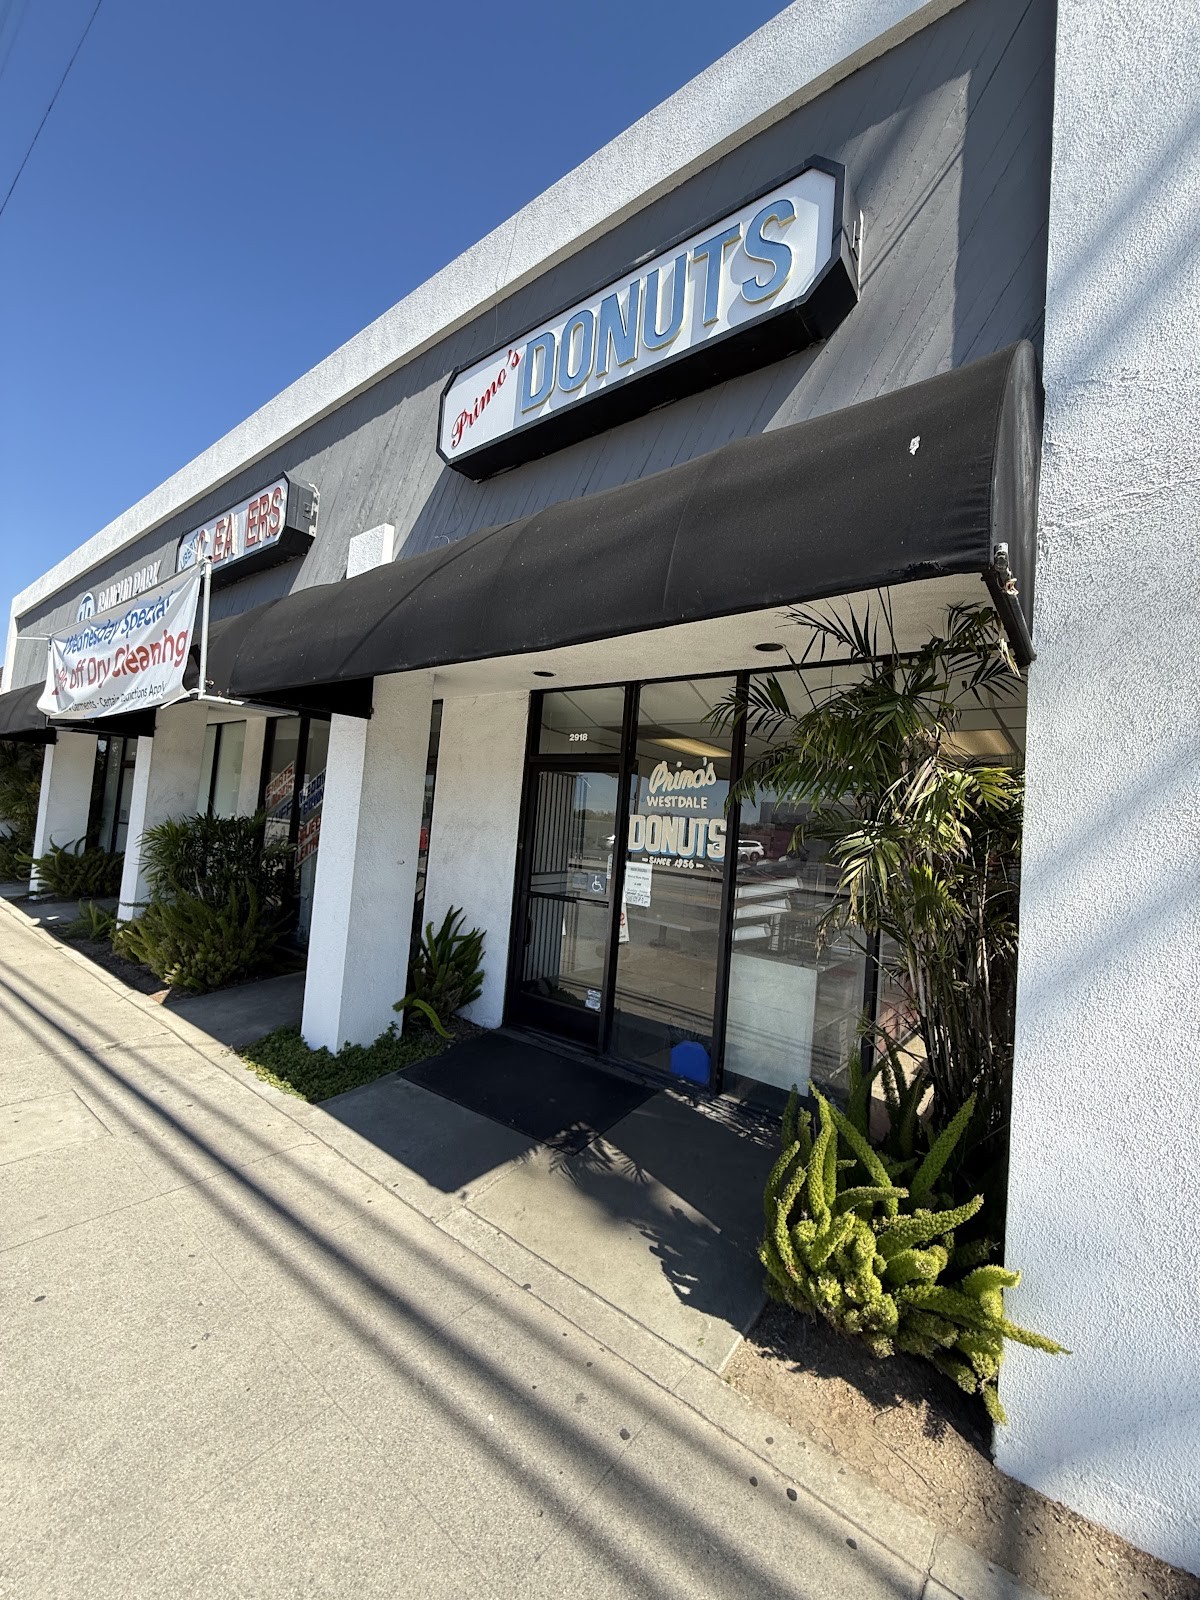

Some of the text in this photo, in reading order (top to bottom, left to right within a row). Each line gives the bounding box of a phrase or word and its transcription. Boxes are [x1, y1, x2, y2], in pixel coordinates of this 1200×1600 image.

[452, 199, 797, 448] Primo's DONUTS
[70, 659, 87, 689] off
[87, 657, 110, 689] Dry
[569, 733, 588, 742] 2918
[648, 757, 717, 794] Primo's
[646, 795, 708, 810] WESTDALE
[628, 814, 728, 861] DONUTS
[648, 856, 695, 869] SINCE 1956
